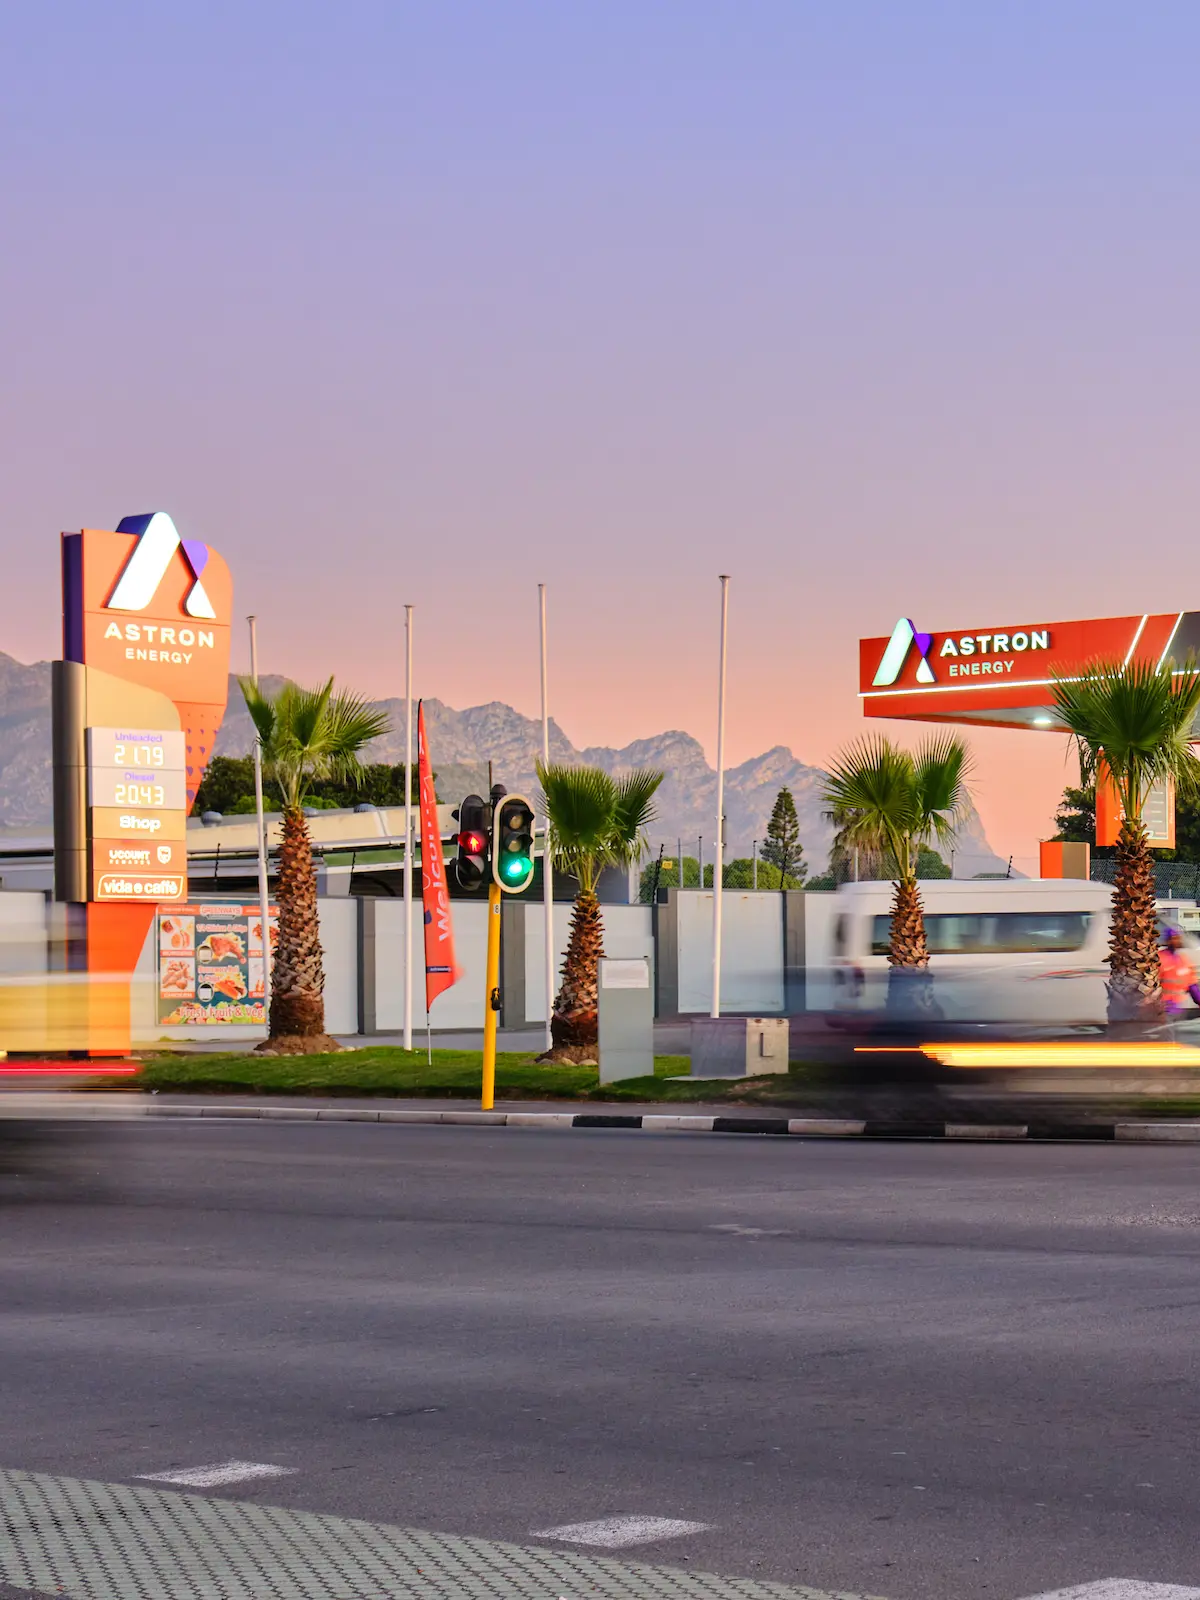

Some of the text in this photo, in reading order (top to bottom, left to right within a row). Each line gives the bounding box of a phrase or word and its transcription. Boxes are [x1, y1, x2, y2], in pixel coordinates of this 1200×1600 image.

[104, 621, 214, 649] ASTRON
[940, 630, 1049, 657] ASTRON
[125, 647, 193, 665] ENERGY
[949, 659, 1014, 677] ENERGY
[115, 732, 163, 743] Unleaded
[124, 772, 155, 781] Diesel
[119, 815, 161, 833] Shop
[103, 879, 133, 894] vida
[133, 882, 143, 894] e
[180, 1007, 206, 1017] Fresh
[210, 1007, 232, 1017] Fruit
[246, 1006, 263, 1018] Veg
